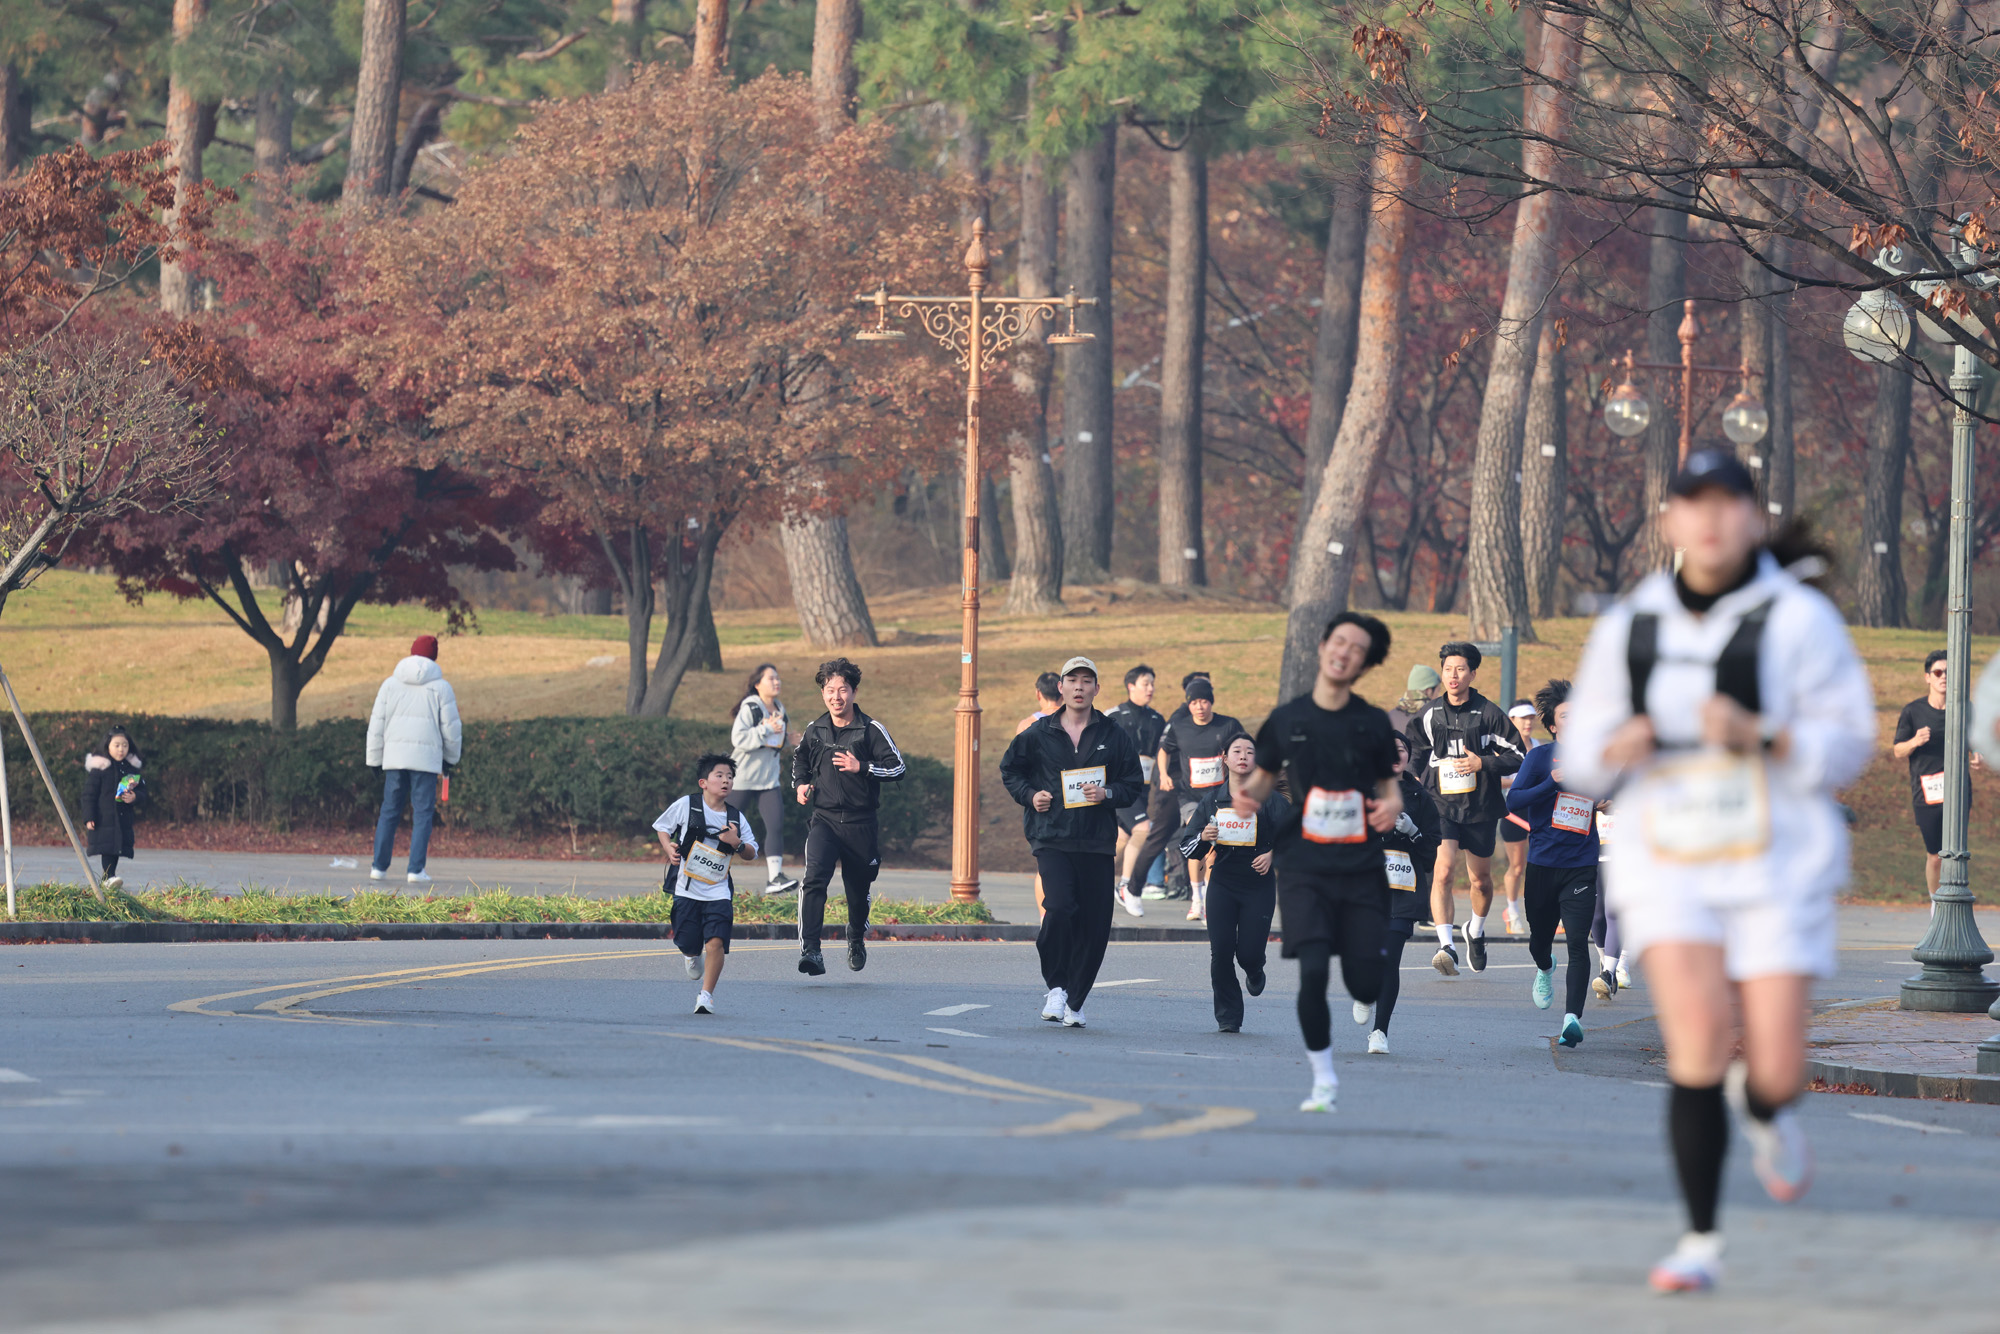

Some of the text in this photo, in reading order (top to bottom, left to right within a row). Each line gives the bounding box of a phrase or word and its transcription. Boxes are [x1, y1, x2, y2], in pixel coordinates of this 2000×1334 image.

[1560, 806, 1590, 818] W3303
[1219, 820, 1251, 830] W6047
[693, 854, 725, 872] M5050
